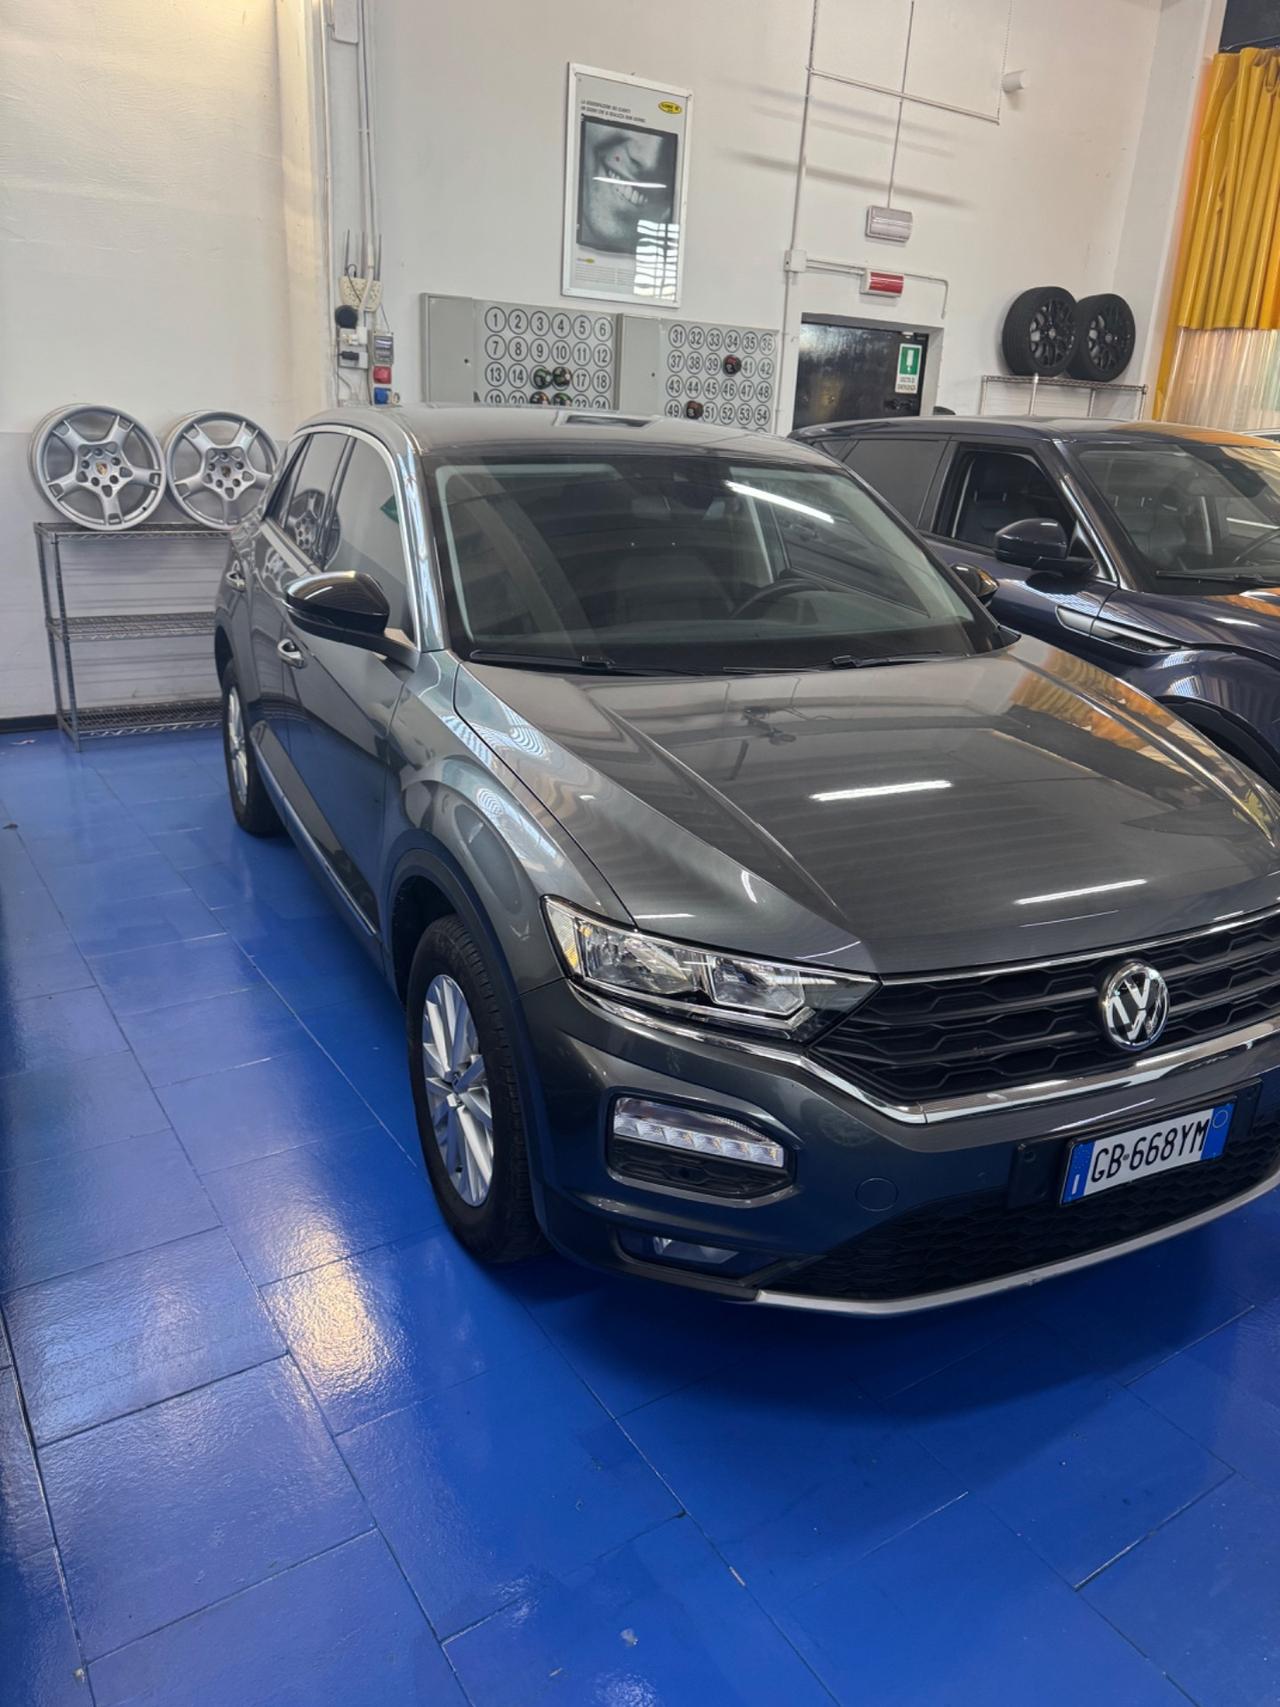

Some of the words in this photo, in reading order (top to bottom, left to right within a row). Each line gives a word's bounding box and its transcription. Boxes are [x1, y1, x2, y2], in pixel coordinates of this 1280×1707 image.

[673, 329, 683, 343] 31
[692, 331, 701, 345] 32
[709, 333, 720, 346] 33
[727, 335, 738, 348] 34
[745, 337, 755, 349] 35
[556, 345, 567, 360] 10
[578, 348, 587, 361] 11
[597, 349, 608, 363] 12
[671, 355, 681, 368] 37
[690, 356, 700, 369] 38
[708, 357, 718, 371] 39
[743, 360, 752, 373] 41
[760, 362, 771, 375] 42
[490, 368, 501, 382] 13
[512, 370, 524, 383] 14
[576, 374, 587, 388] 17
[597, 375, 607, 389] 18
[669, 380, 680, 393] 43
[687, 382, 698, 394] 44
[706, 383, 716, 395] 45
[723, 384, 734, 397] 46
[741, 385, 752, 398] 47
[758, 387, 769, 400] 48
[668, 405, 679, 418] 49
[705, 406, 714, 419] 51
[722, 407, 733, 420] 52
[740, 409, 750, 421] 53
[757, 409, 767, 422] 54
